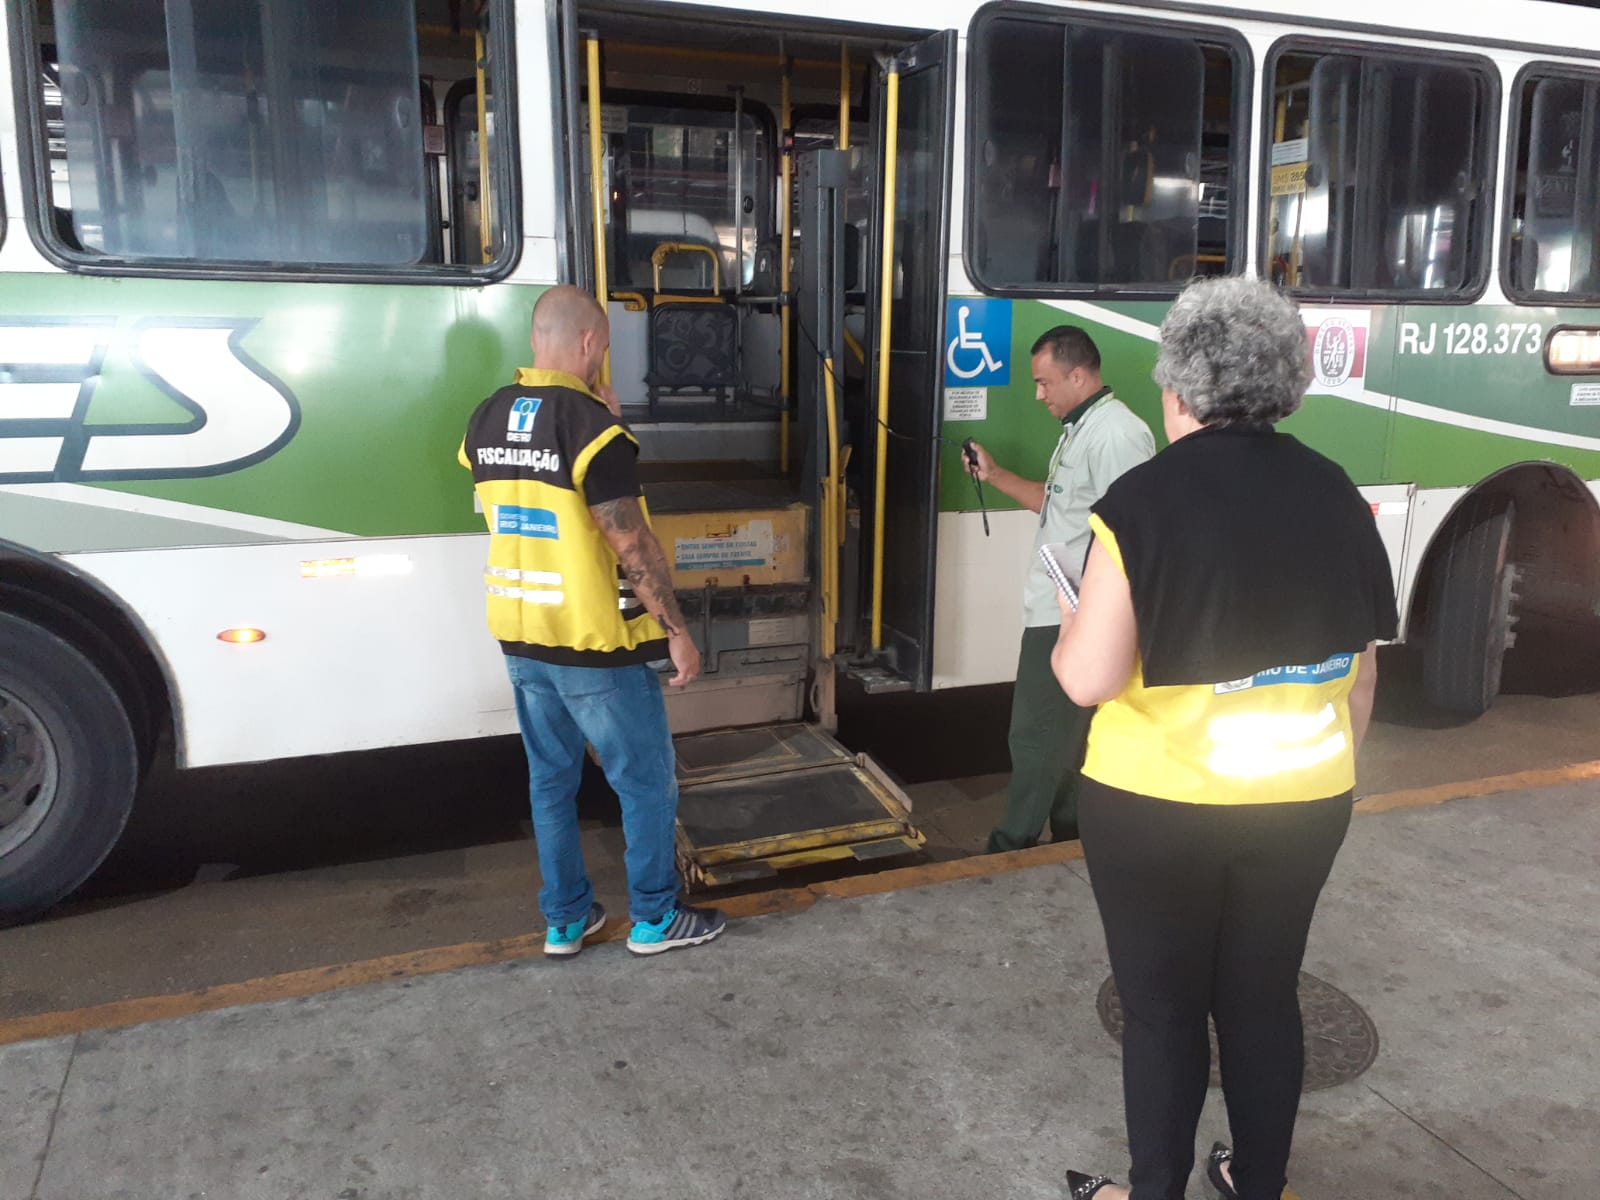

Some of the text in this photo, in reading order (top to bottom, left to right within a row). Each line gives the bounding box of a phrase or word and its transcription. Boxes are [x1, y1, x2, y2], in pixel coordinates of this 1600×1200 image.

[1399, 322, 1542, 354] RJ 128.373
[1285, 665, 1308, 674] DE
[1311, 656, 1350, 675] JANEIRO
